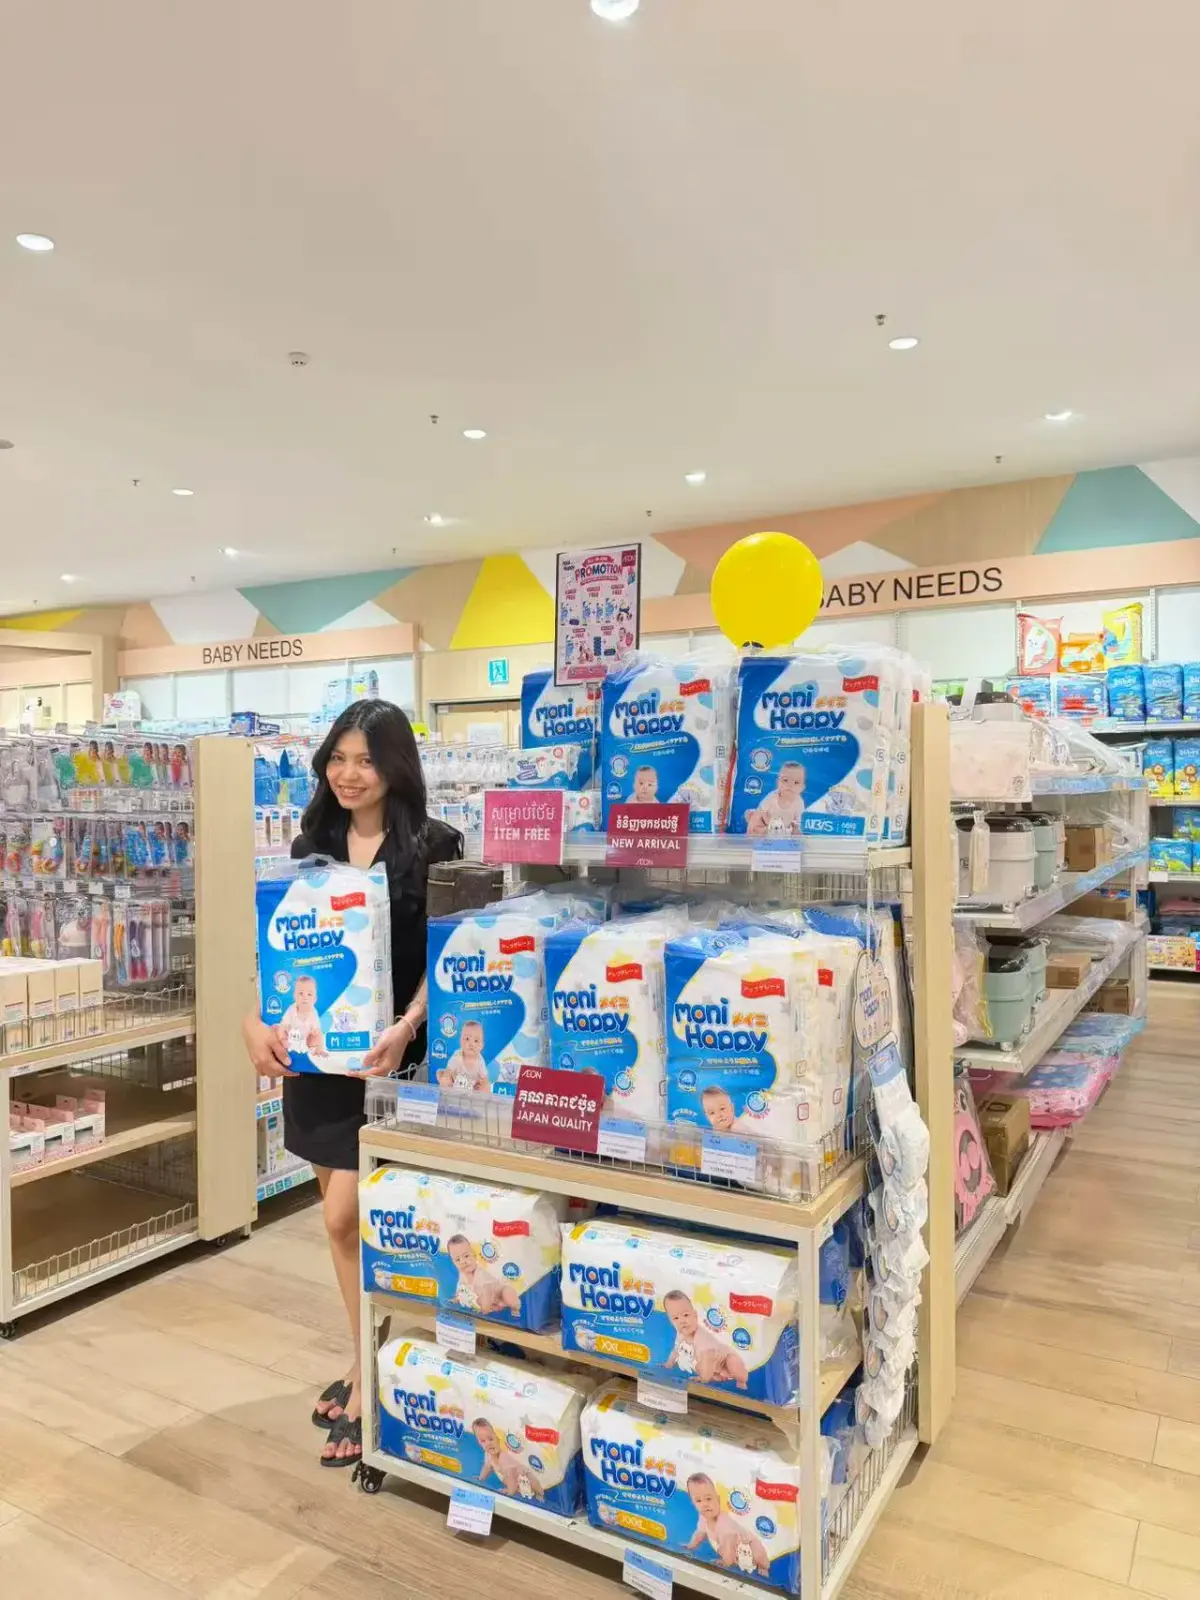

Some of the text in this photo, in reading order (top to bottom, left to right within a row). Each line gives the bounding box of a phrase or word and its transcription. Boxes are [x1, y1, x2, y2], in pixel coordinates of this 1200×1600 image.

[575, 564, 622, 582] PROMOTION
[819, 567, 1003, 608] ABY NEEDS
[203, 639, 303, 664] BABY NEEDS
[623, 713, 685, 738] Happy
[769, 711, 845, 729] Happy
[494, 826, 551, 841] ITEM FREE
[611, 838, 680, 850] NEW ARRIVAL
[284, 929, 345, 951] Happy
[452, 974, 514, 993] Happy
[562, 1011, 629, 1033] Happy
[330, 1036, 340, 1047] M
[685, 1025, 769, 1052] Happy
[517, 1110, 593, 1132] JAPAN QUALITY
[379, 1226, 441, 1255] Happy
[580, 1284, 655, 1318] Happy
[404, 1407, 464, 1438] Happy
[600, 1460, 677, 1497] Happy
